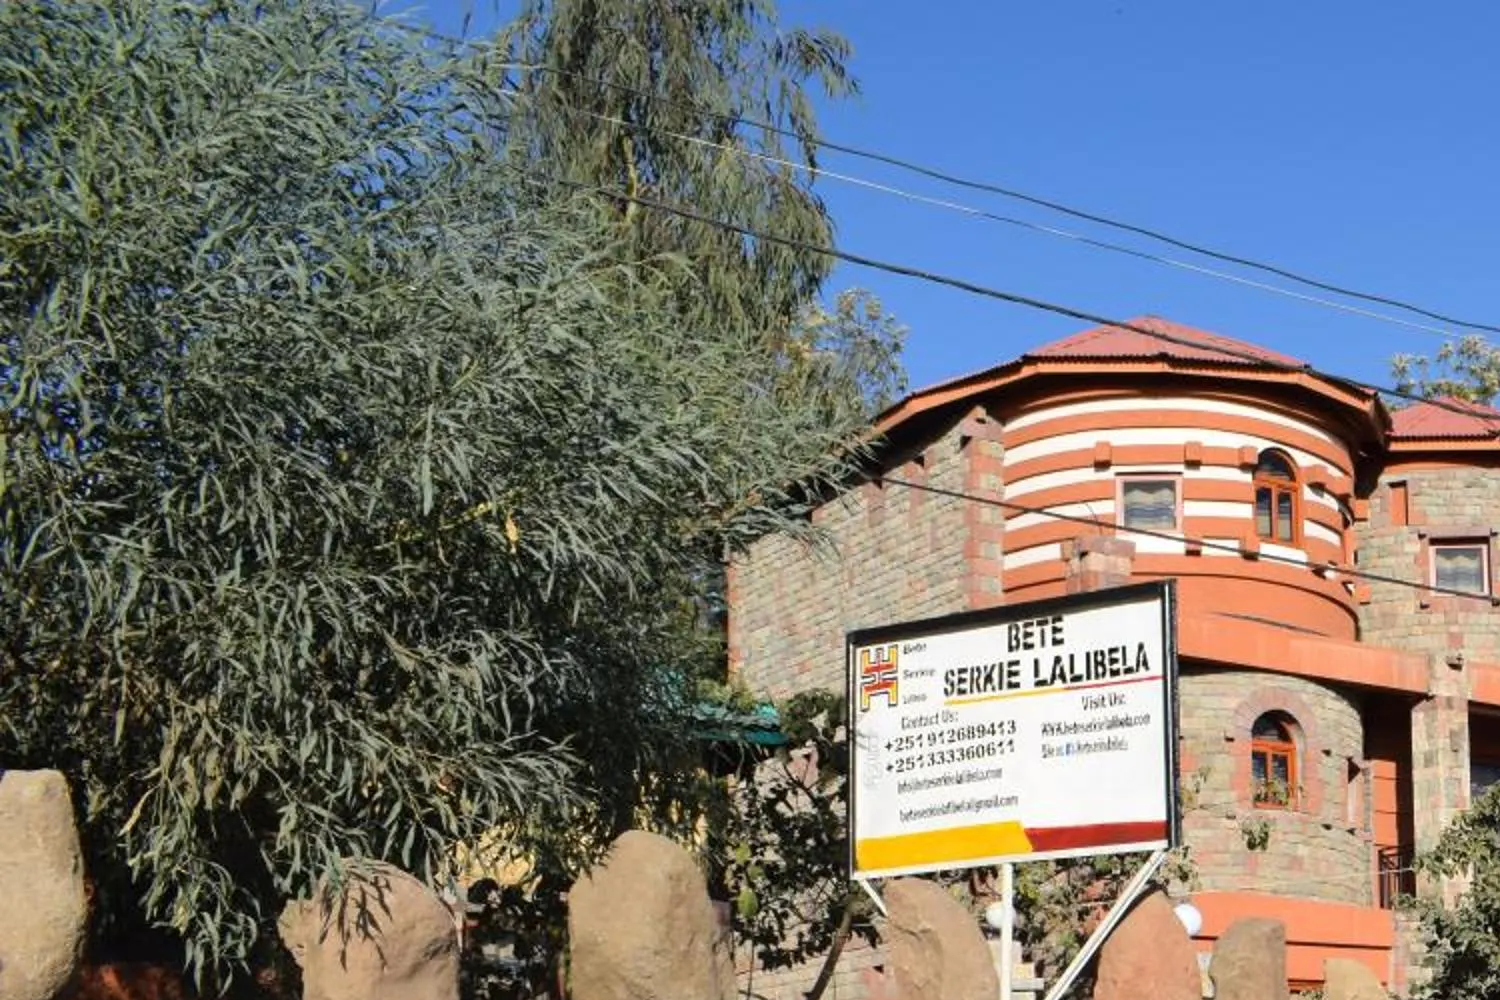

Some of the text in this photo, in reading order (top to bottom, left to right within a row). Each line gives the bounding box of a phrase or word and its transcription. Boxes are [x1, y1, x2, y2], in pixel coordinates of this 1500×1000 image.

[1007, 616, 1064, 652] BETE
[943, 642, 1150, 697] SERKIE LALIBELA
[1081, 694, 1106, 711] Visit
[901, 712, 938, 730] Contact
